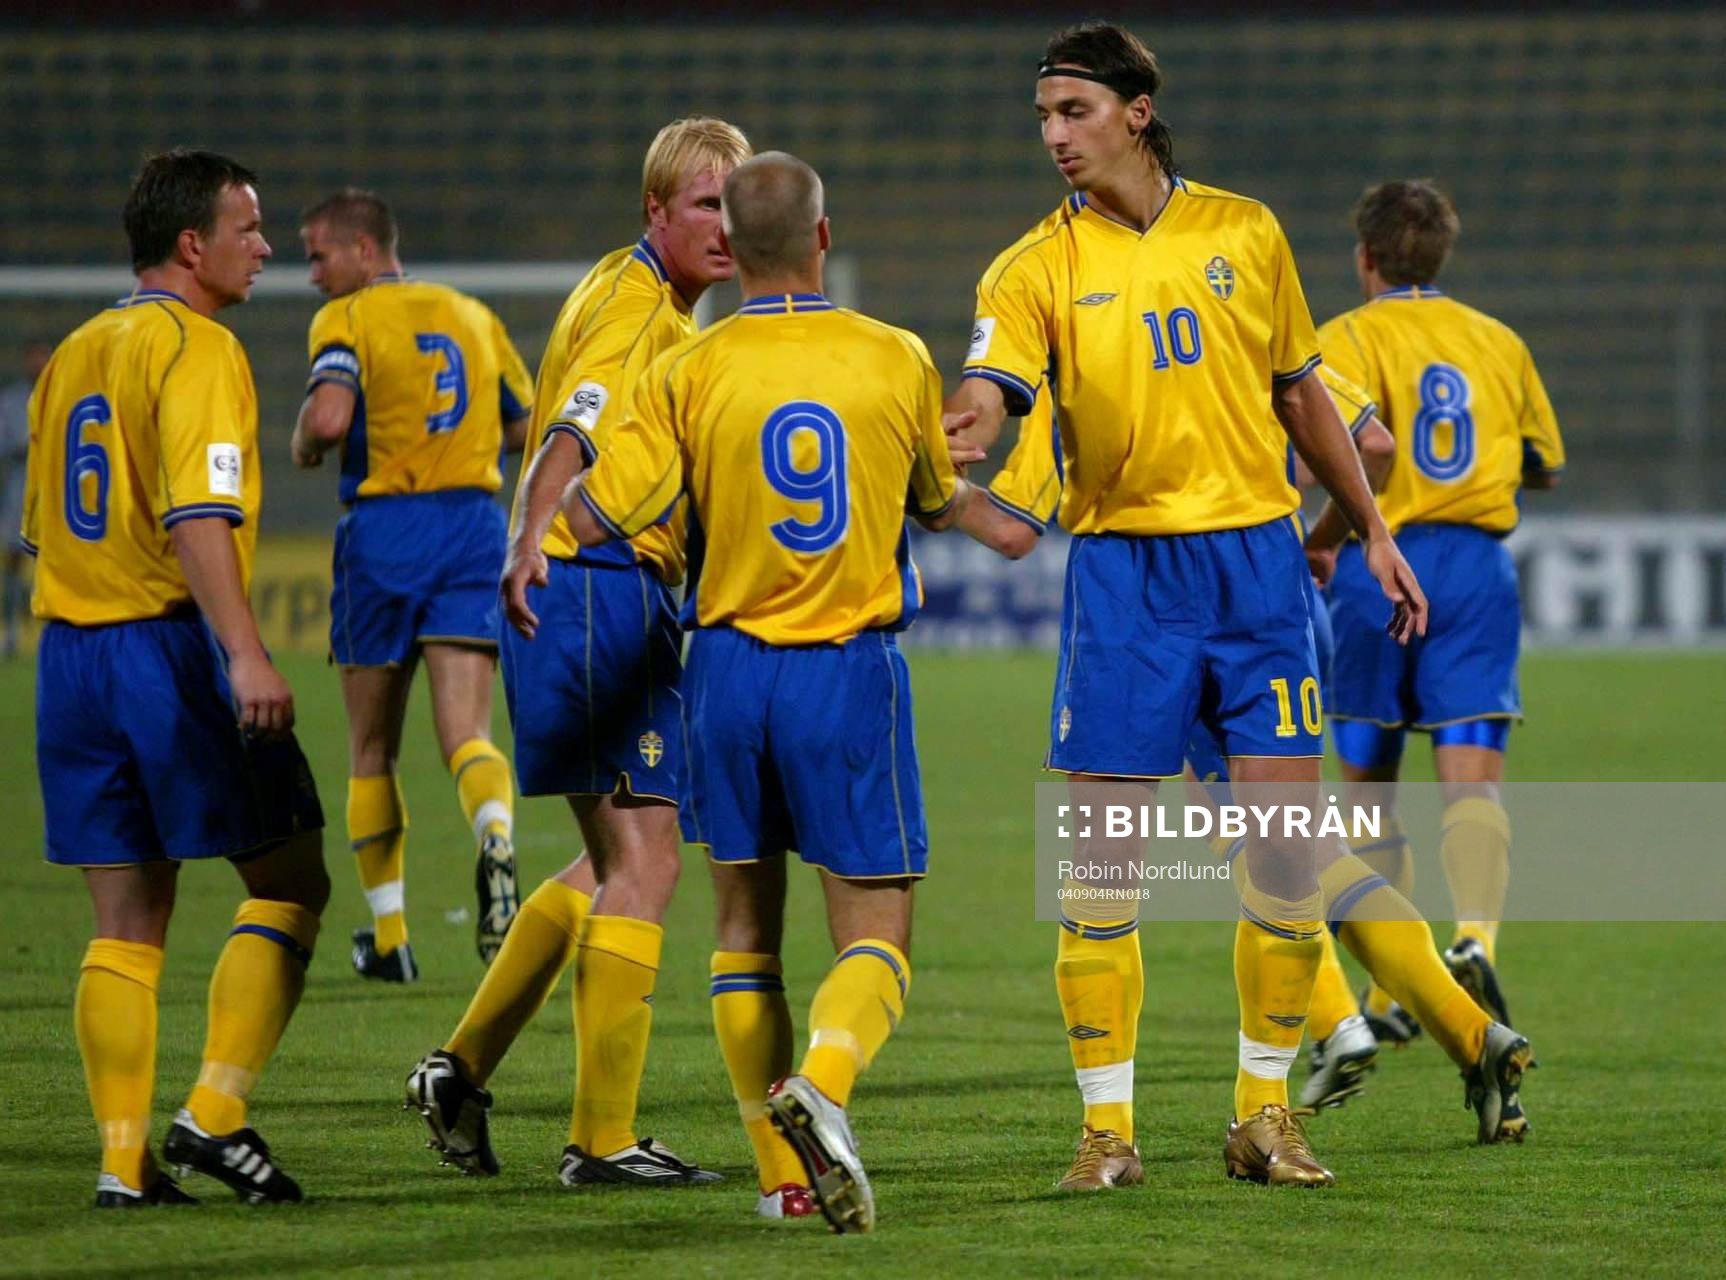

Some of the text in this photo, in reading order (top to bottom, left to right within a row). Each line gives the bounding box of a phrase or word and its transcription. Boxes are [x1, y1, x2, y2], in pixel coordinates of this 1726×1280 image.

[415, 333, 469, 435] 3
[1142, 306, 1202, 370] 10
[64, 393, 112, 543] 6
[760, 400, 850, 554] 9
[1412, 362, 1475, 482] 8
[1270, 676, 1322, 737] 10
